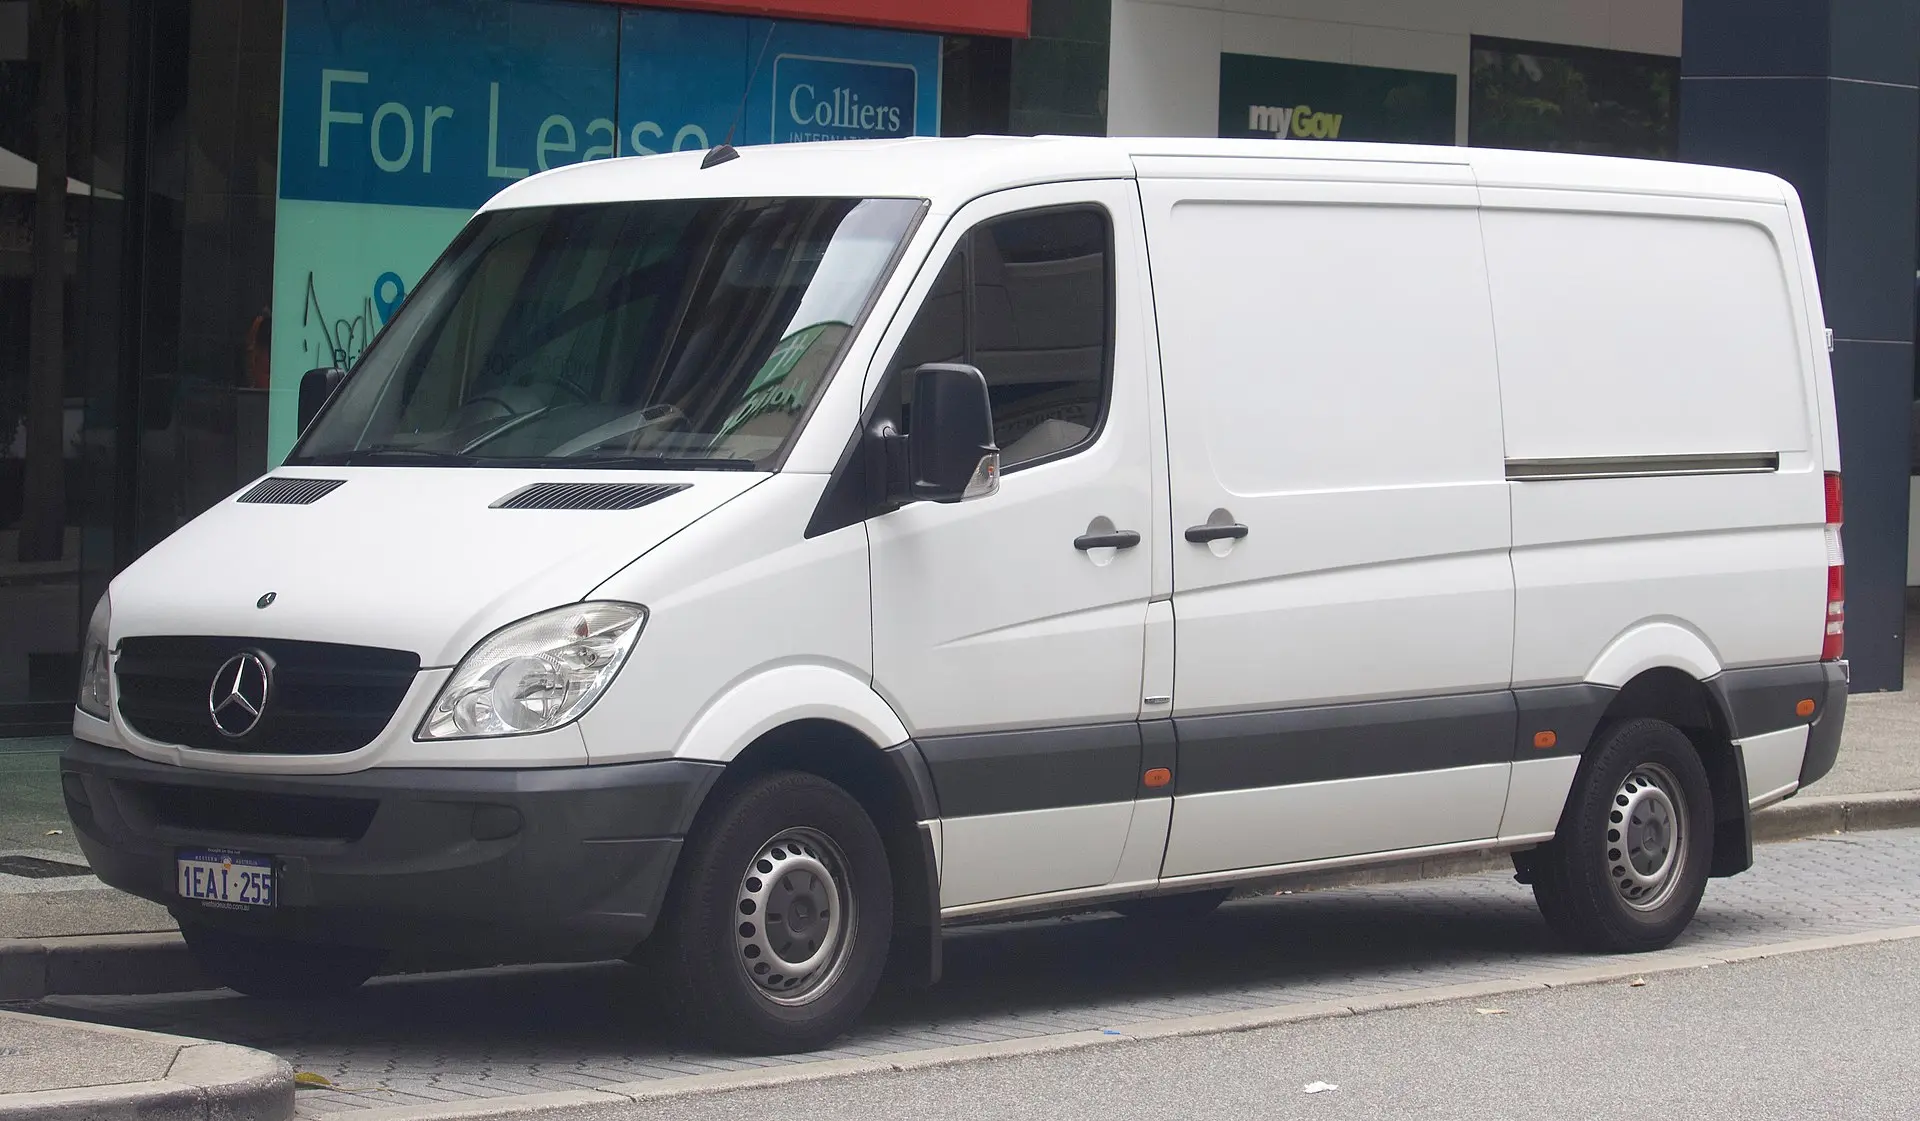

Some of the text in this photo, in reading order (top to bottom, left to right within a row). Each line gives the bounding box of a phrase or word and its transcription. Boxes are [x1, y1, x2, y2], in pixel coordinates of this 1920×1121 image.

[318, 68, 454, 173] For
[789, 83, 900, 132] Colliers
[1249, 104, 1343, 140] myGov
